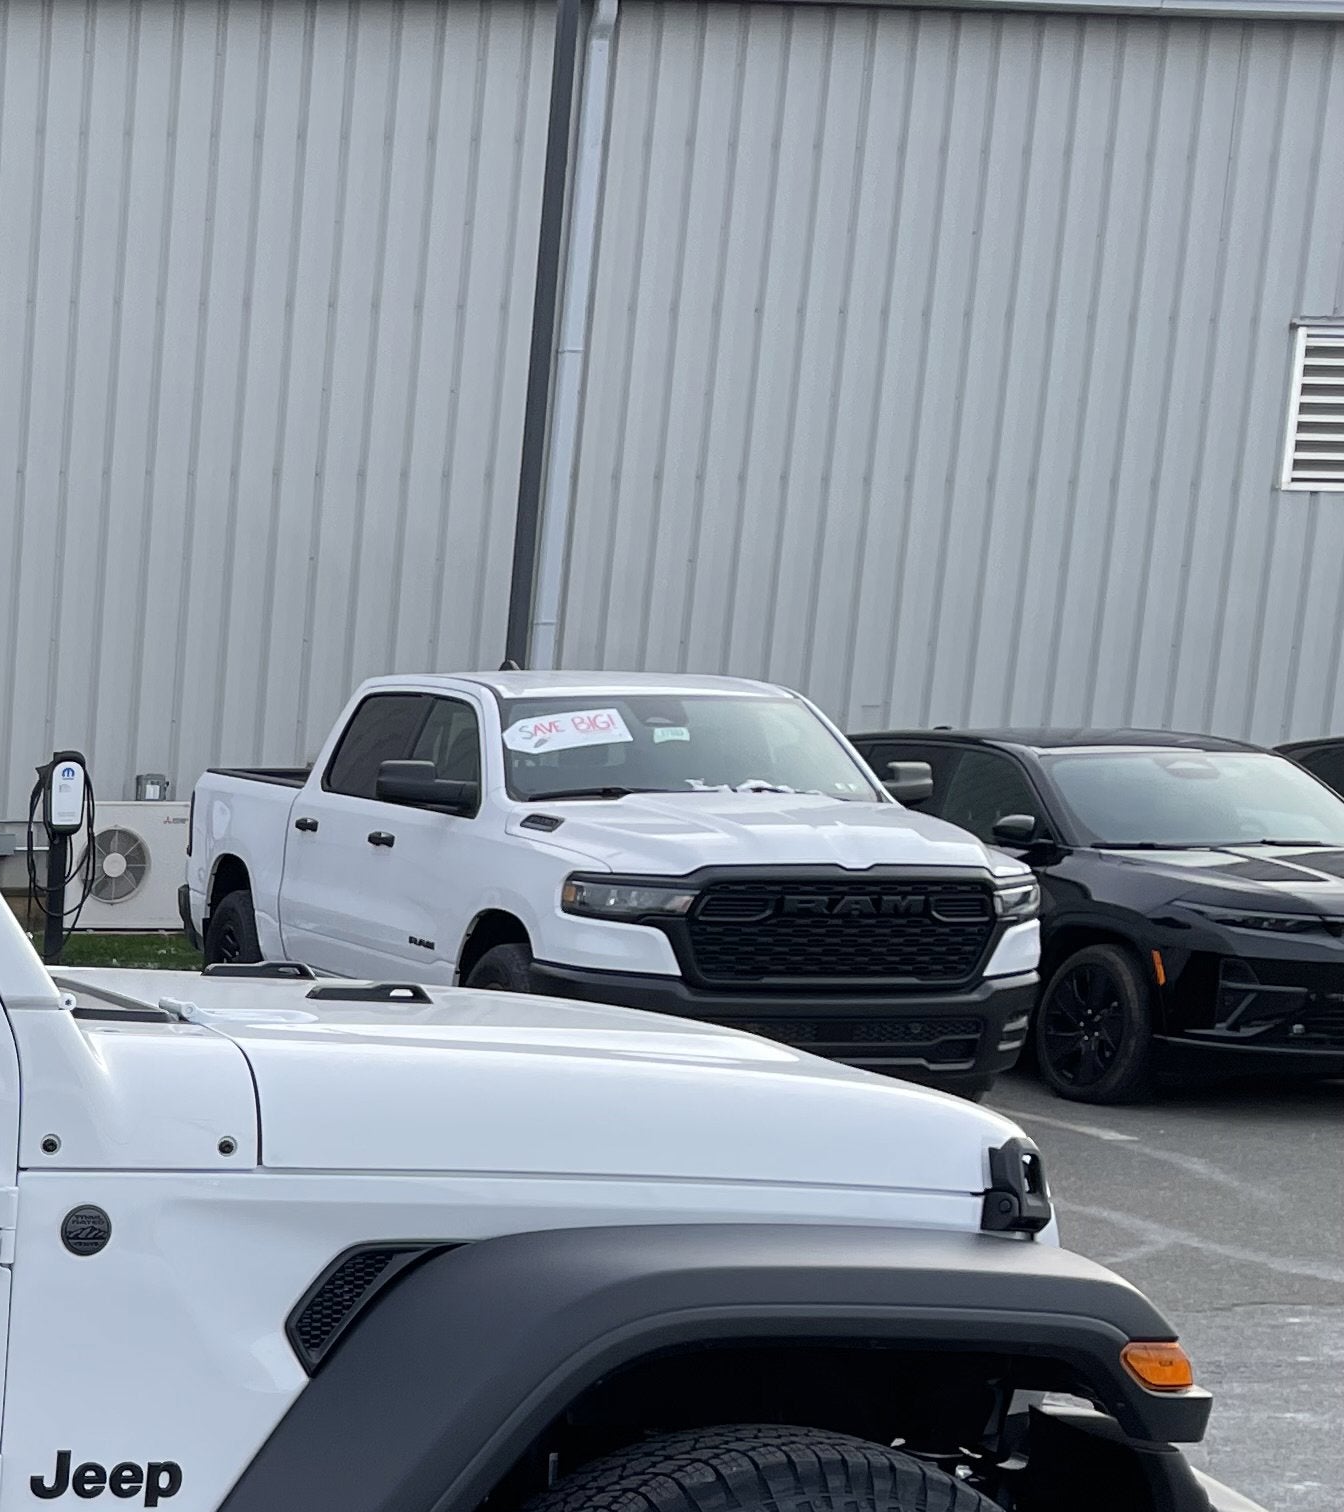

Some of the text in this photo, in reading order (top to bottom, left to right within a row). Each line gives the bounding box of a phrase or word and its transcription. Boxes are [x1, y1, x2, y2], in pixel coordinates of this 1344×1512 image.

[518, 713, 617, 740] SAVE BIG!
[783, 895, 927, 914] RAM
[30, 1449, 183, 1508] Jeep
